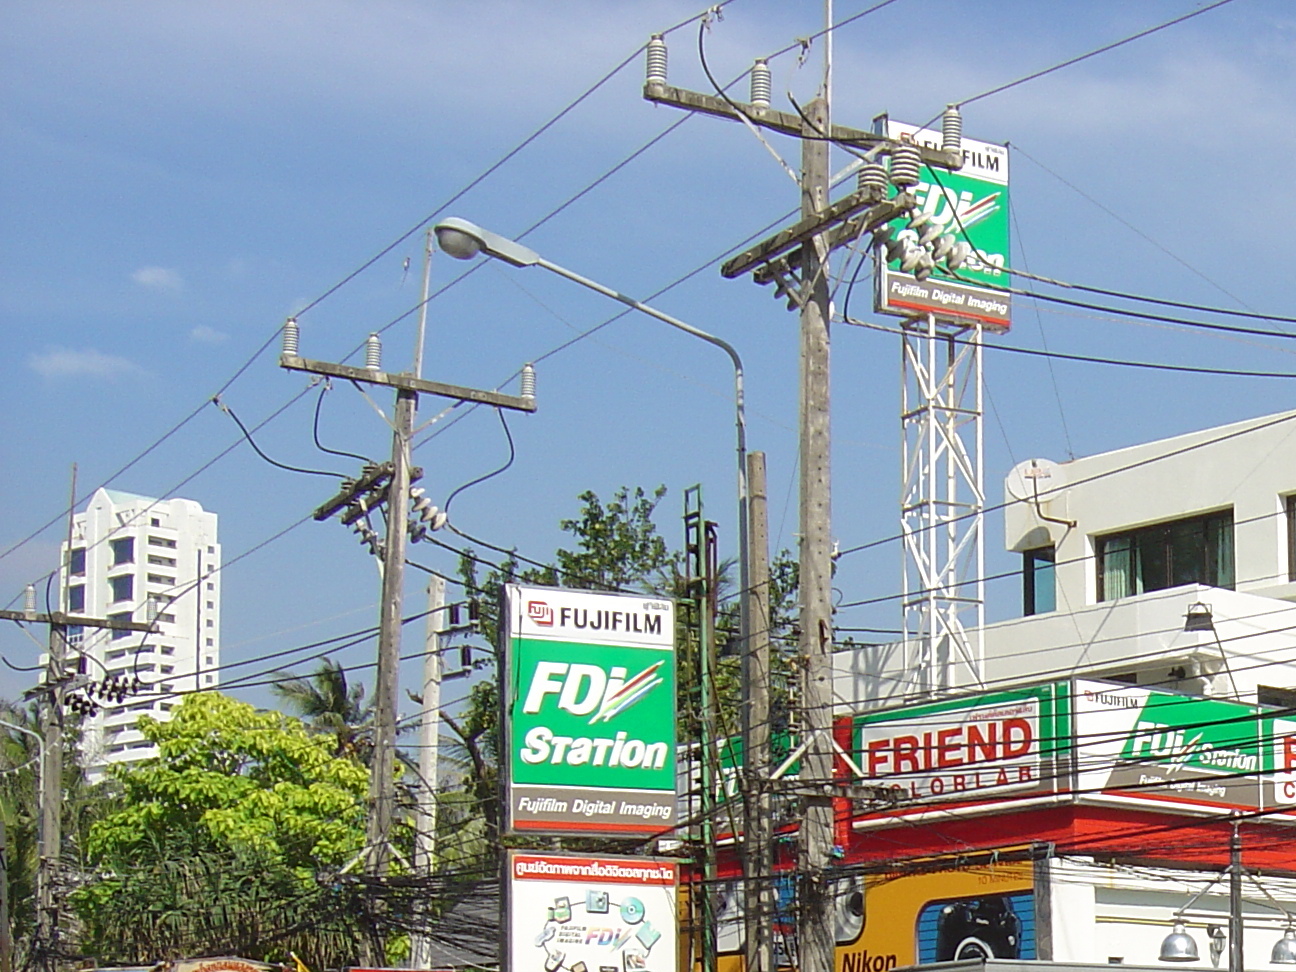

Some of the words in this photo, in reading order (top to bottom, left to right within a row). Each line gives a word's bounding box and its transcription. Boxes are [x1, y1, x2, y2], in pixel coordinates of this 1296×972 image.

[891, 281, 929, 298] Fujifilm
[931, 288, 965, 306] Digital
[967, 296, 1008, 315] Imaging
[560, 607, 662, 635] FUJIFILM
[523, 661, 628, 716] FDi
[1095, 693, 1138, 709] FUJIFILM
[868, 718, 1033, 778] FRIEND
[518, 797, 567, 814] Fujifilm
[572, 799, 617, 817] Digital
[619, 802, 672, 820] Imaging
